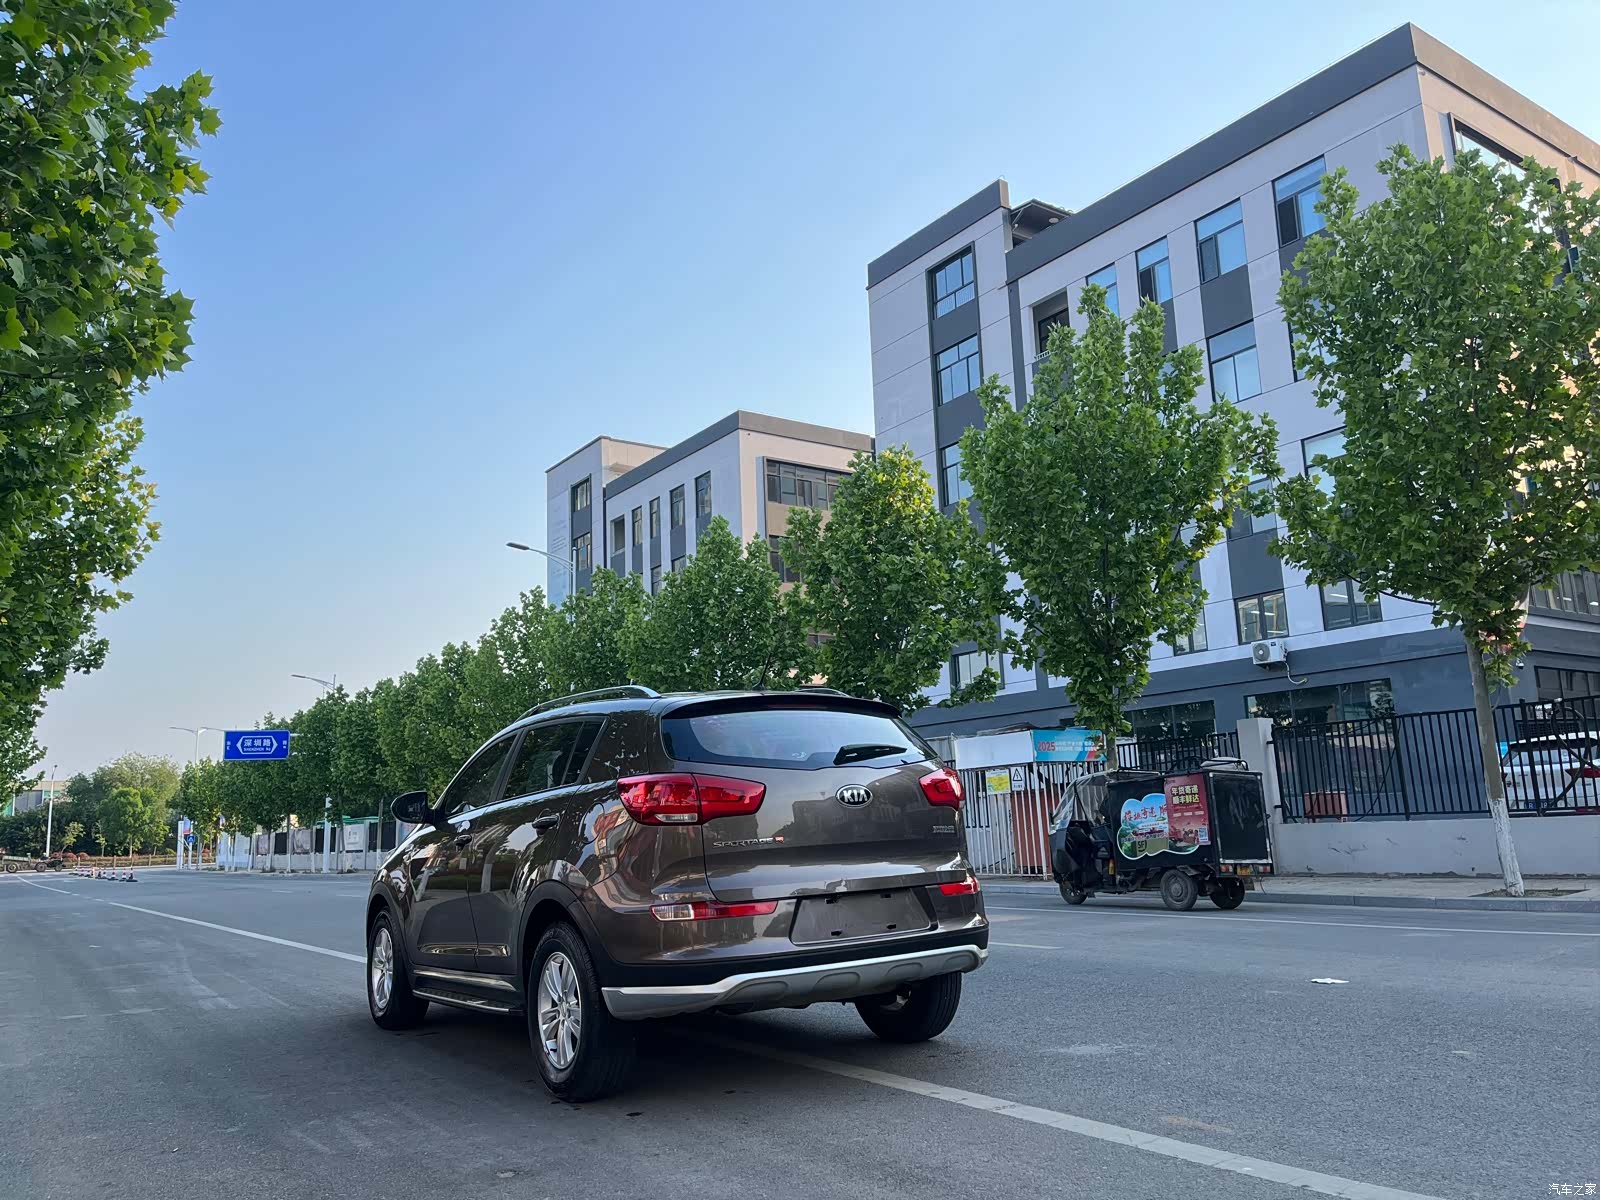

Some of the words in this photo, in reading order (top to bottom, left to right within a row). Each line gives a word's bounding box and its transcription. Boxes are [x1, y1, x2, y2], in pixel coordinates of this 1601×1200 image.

[243, 739, 271, 747] 深圳路
[1037, 741, 1056, 751] 2025
[843, 789, 868, 802] KIA
[713, 837, 773, 848] SPORTAGE
[1137, 840, 1145, 849] SF
